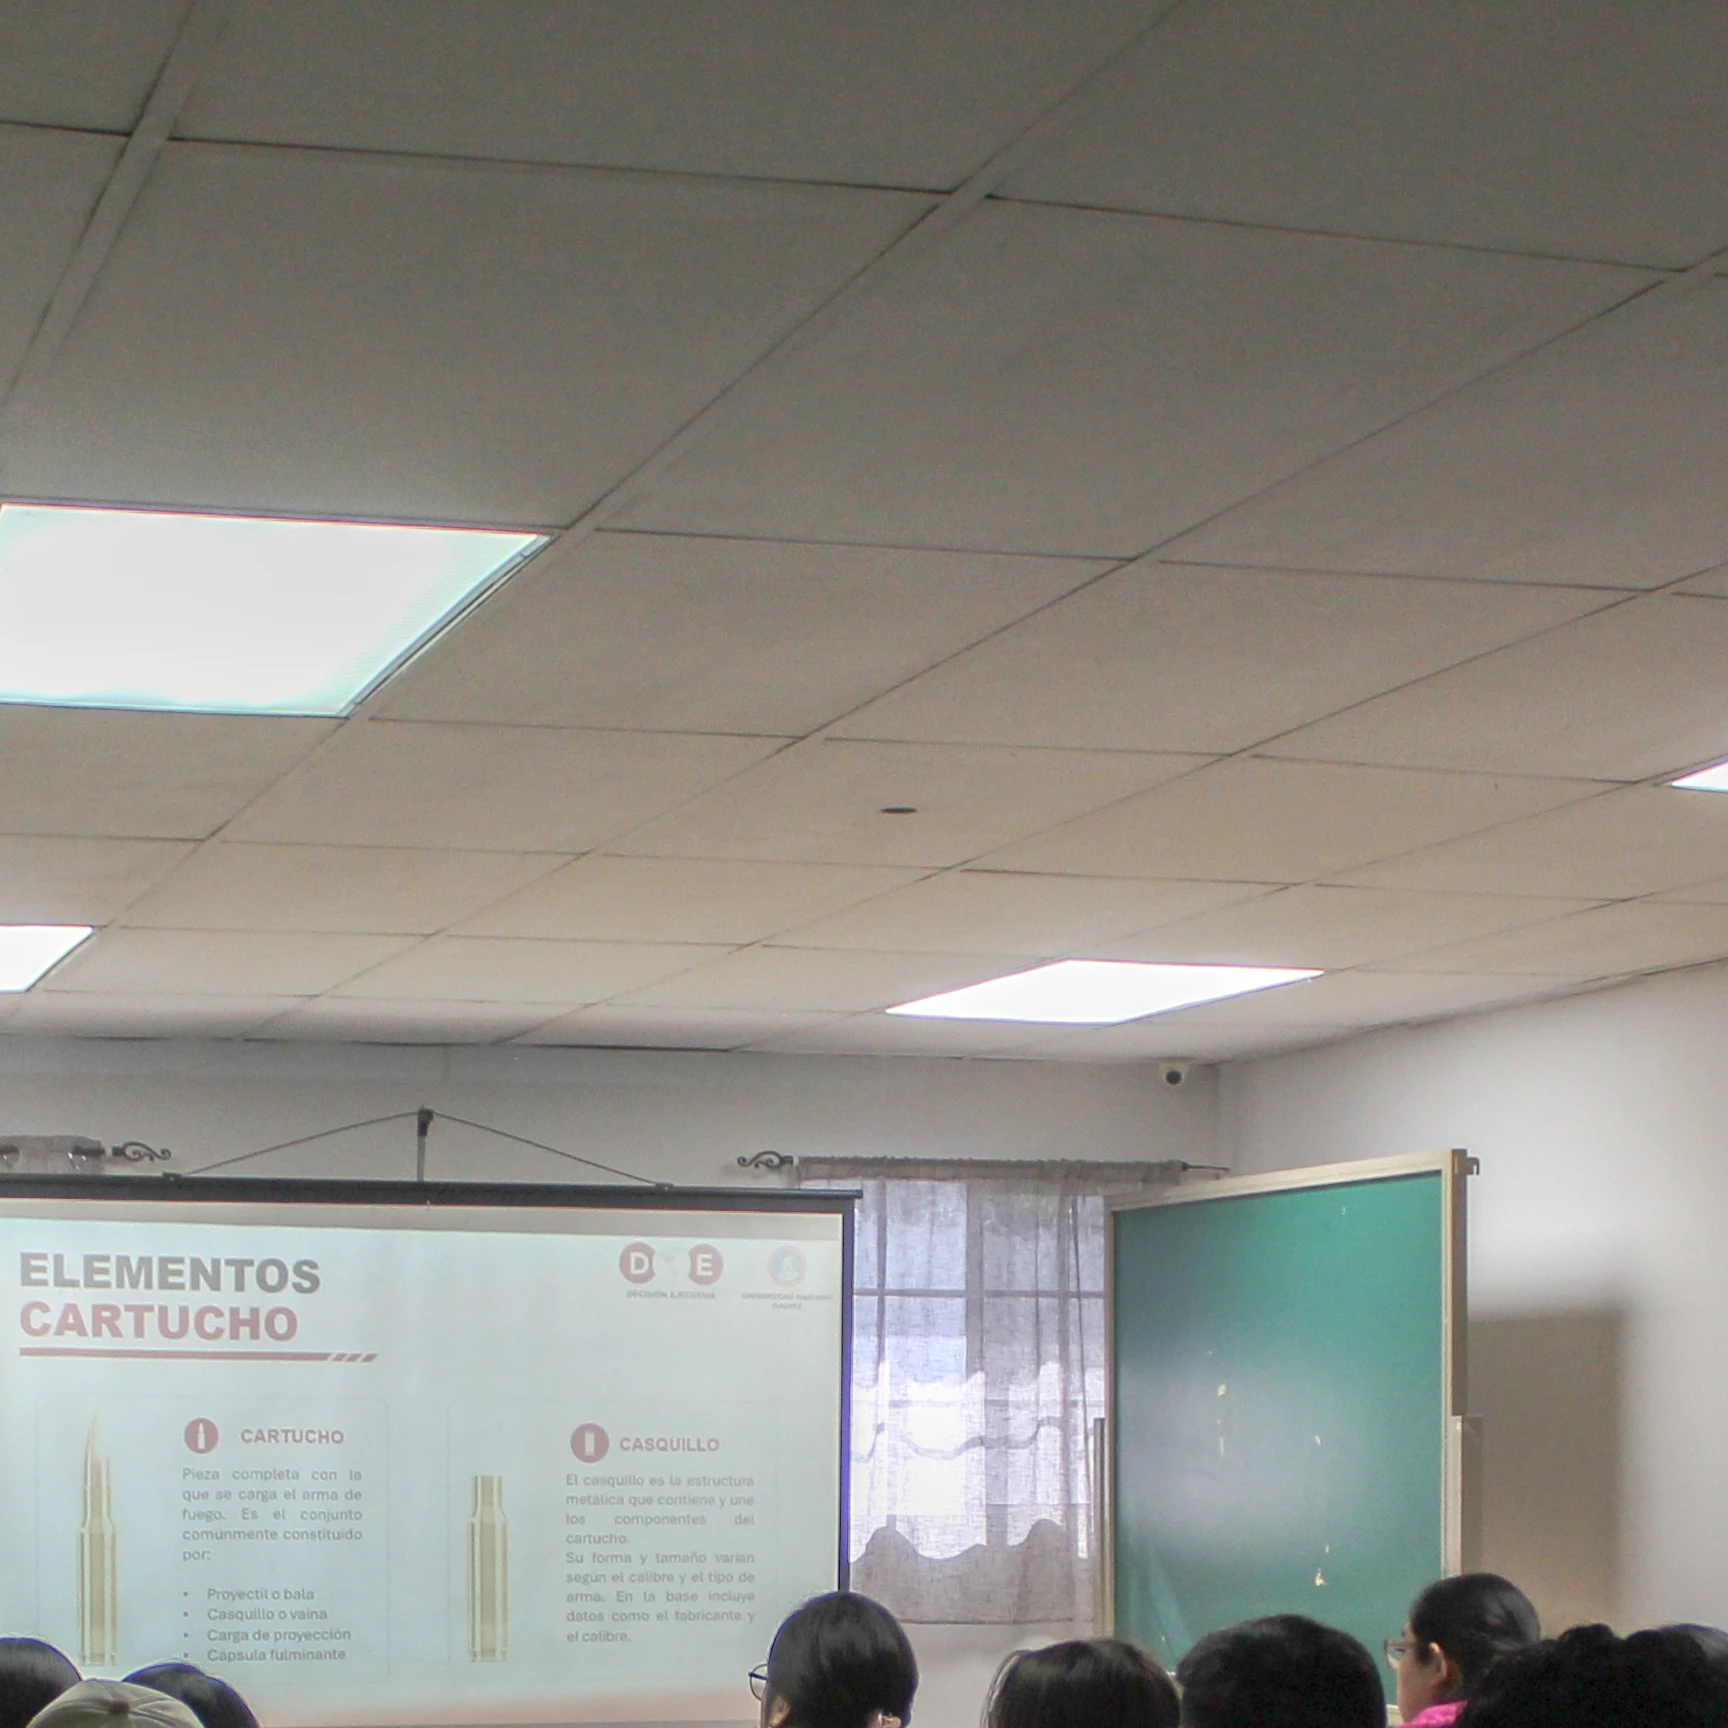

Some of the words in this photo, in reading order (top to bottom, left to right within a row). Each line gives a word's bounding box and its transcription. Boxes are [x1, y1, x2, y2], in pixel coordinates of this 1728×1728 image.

[629, 1252, 650, 1274] D
[696, 1253, 713, 1276] E
[19, 1251, 321, 1294] ELEMENTOS
[19, 1301, 300, 1342] CARTUCHO
[241, 1429, 344, 1444] CARTUCHO
[619, 1438, 719, 1452] CASQUILLO
[183, 1468, 220, 1481] Pieza
[232, 1468, 300, 1482] completa
[311, 1470, 337, 1481] con
[349, 1469, 362, 1481] la
[566, 1474, 578, 1486] El
[583, 1474, 644, 1488] casquillo
[649, 1476, 664, 1486] es
[670, 1475, 681, 1486] la
[687, 1476, 754, 1487] estructura
[183, 1490, 209, 1501] que
[216, 1490, 232, 1500] se
[238, 1490, 277, 1502] carga
[283, 1488, 296, 1500] el
[302, 1490, 338, 1500] arma
[345, 1489, 362, 1500] de
[629, 1495, 653, 1508] que
[657, 1494, 715, 1506] contiene
[719, 1496, 726, 1508] y
[730, 1496, 754, 1506] une
[182, 1508, 226, 1522] fuego.
[242, 1508, 258, 1520] Es
[273, 1508, 285, 1520] el
[300, 1508, 362, 1522] conjunto
[566, 1514, 585, 1525] los
[614, 1514, 707, 1527] componentes
[734, 1514, 755, 1525] del
[566, 1534, 630, 1545] cartucho.
[182, 1549, 211, 1562] por:
[566, 1553, 583, 1564] Su
[592, 1553, 632, 1564] forma
[640, 1555, 647, 1566] y
[611, 1572, 623, 1584] el
[629, 1572, 673, 1584] calibre
[678, 1573, 685, 1585] y
[691, 1572, 703, 1584] el
[708, 1572, 734, 1586] tipo
[738, 1572, 755, 1584] de
[207, 1588, 268, 1602] Proyectil
[272, 1590, 280, 1600] o
[283, 1588, 314, 1600] bala
[566, 1592, 605, 1603] arma.
[616, 1591, 633, 1602] En
[644, 1591, 655, 1602] la
[666, 1591, 698, 1602] base
[708, 1591, 755, 1604] incluye
[207, 1608, 274, 1621] Casquillo
[278, 1610, 287, 1620] o
[290, 1608, 327, 1620] vaina
[566, 1611, 605, 1622] datos
[611, 1613, 649, 1622] como
[656, 1611, 668, 1622] el
[675, 1611, 741, 1622] fabricante
[748, 1612, 755, 1623] y
[207, 1629, 249, 1643] Carga
[252, 1629, 270, 1641] de
[273, 1628, 351, 1643] proyección
[567, 1630, 579, 1643] el
[582, 1630, 631, 1643] calibre.
[270, 1649, 346, 1661] fulminante
